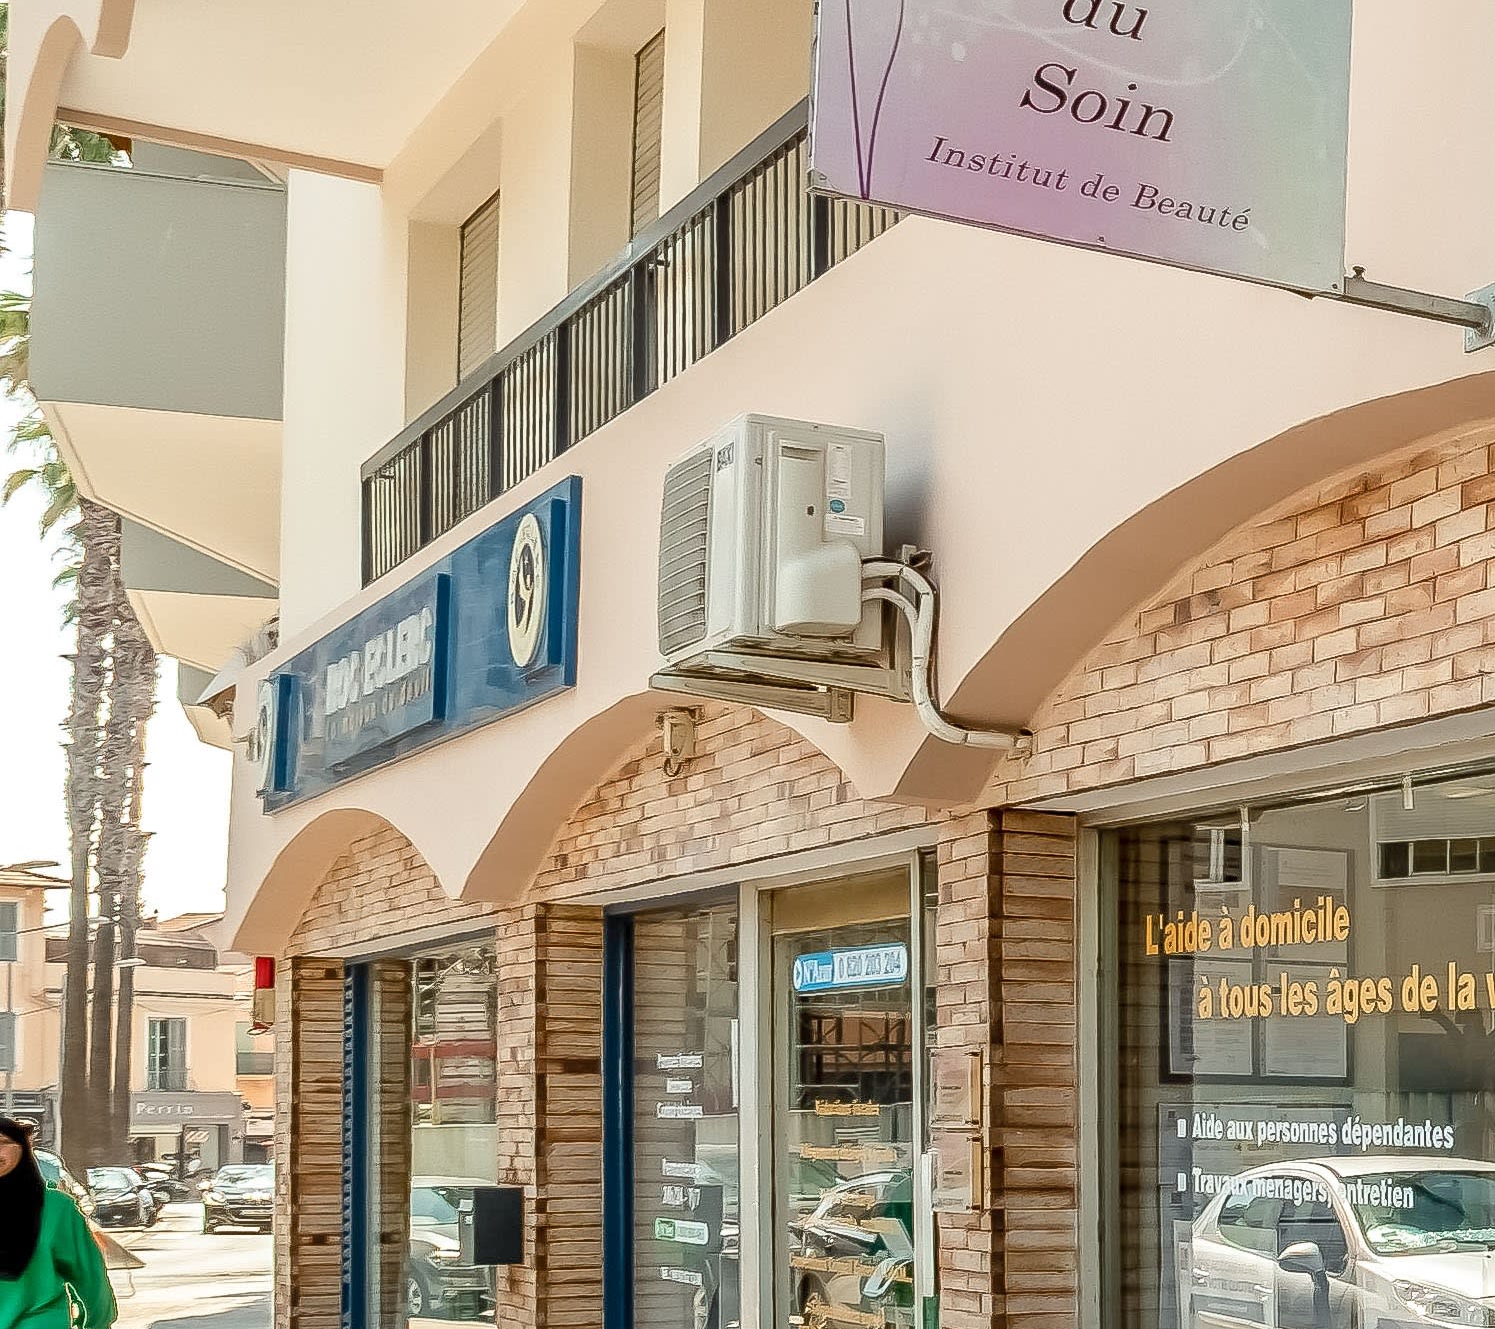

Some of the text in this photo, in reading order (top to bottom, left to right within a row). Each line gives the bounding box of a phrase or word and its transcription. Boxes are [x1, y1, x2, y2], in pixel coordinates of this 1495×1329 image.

[1020, 63, 1176, 142] Soin
[925, 137, 1250, 233] Institut de Beauté
[1145, 895, 1350, 957] L'aide à domicile
[1198, 976, 1213, 1019] à
[1219, 979, 1273, 1018] tous
[1280, 971, 1318, 1016] les
[1326, 968, 1392, 1024] âges
[1401, 964, 1440, 1013] de
[1447, 960, 1476, 1011] la
[1191, 1113, 1455, 1151] Aide aux personnes dépendantes
